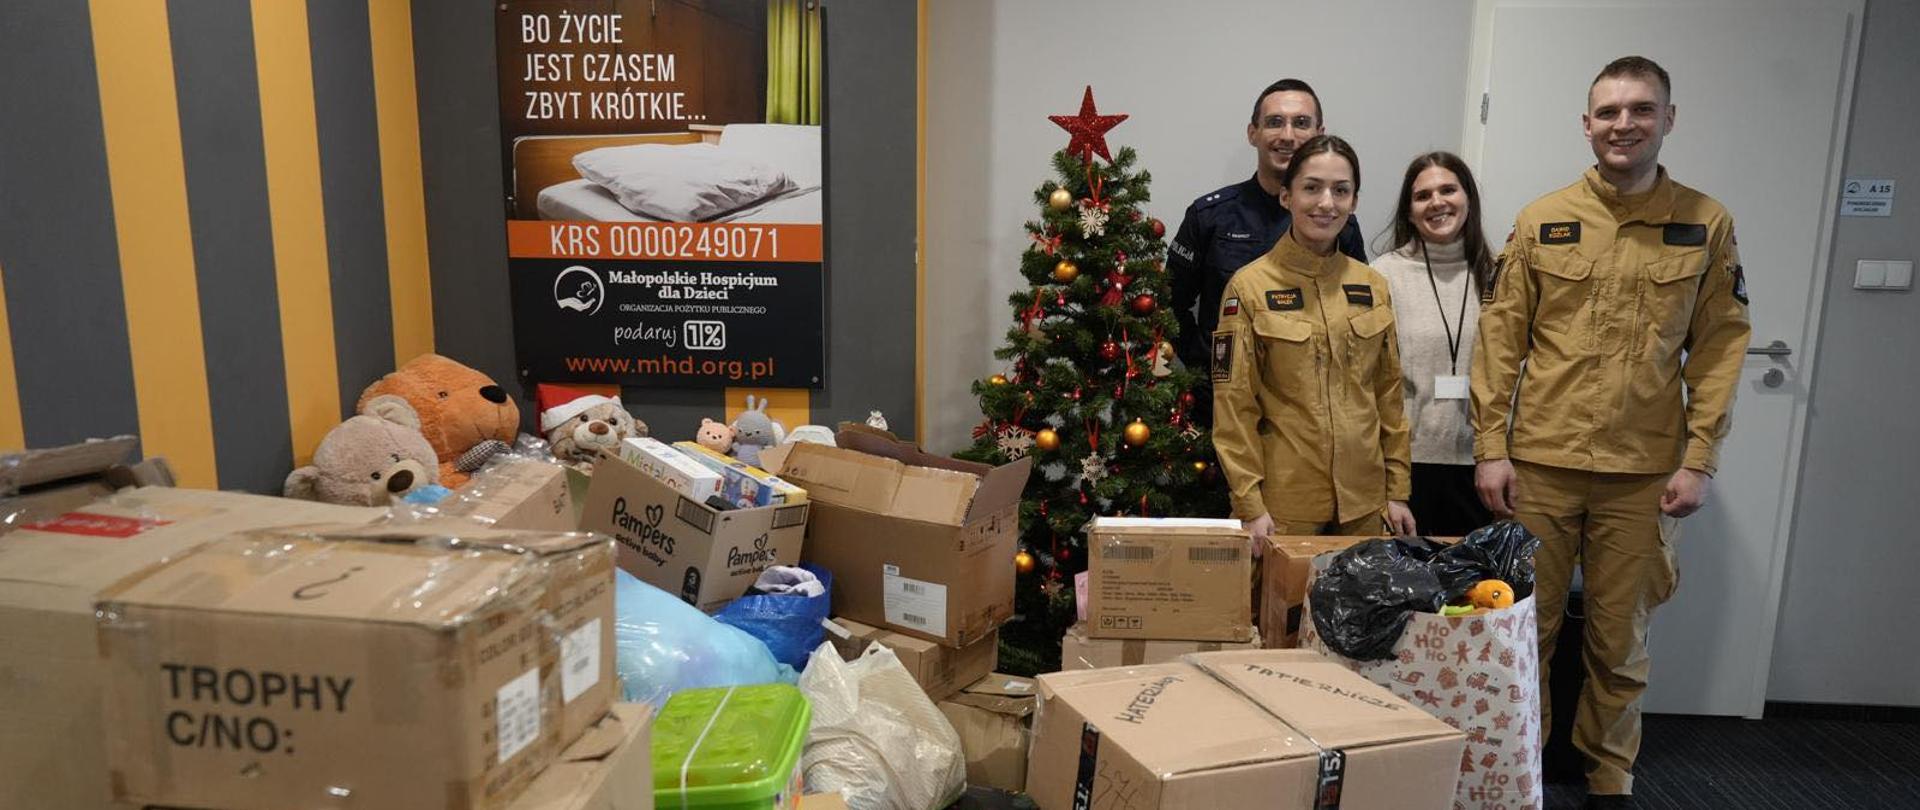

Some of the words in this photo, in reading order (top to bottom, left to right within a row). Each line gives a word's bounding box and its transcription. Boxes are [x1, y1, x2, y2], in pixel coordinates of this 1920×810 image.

[521, 14, 550, 43] BO
[559, 10, 623, 43] ŻYCIE
[524, 54, 574, 82] JEST
[583, 54, 675, 82] CZASEM
[525, 92, 582, 119] ZBYT
[591, 87, 706, 120] KRÓTKIE...
[1869, 185, 1877, 193] A
[1879, 185, 1891, 193] 15
[550, 224, 600, 256] KRS
[610, 225, 778, 258] 0000249071
[608, 270, 698, 288] Małopolskie
[700, 272, 778, 290] Hospicjum
[658, 285, 681, 299] dla
[684, 286, 729, 300] Dzieci
[619, 304, 674, 312] ORGANIZACJA
[711, 305, 767, 314] PUBLICZNEGO
[614, 322, 677, 348] podaruj
[687, 324, 722, 347] 1%
[565, 355, 774, 379] www.mhd.org.pl
[612, 496, 675, 555] Pampers
[615, 533, 642, 553] active
[642, 546, 668, 568] baby
[727, 546, 777, 568] Pampers
[1414, 634, 1445, 649] HO
[160, 663, 354, 713] TROPHY
[166, 710, 294, 755] C/NO:
[1469, 785, 1504, 801] HO
